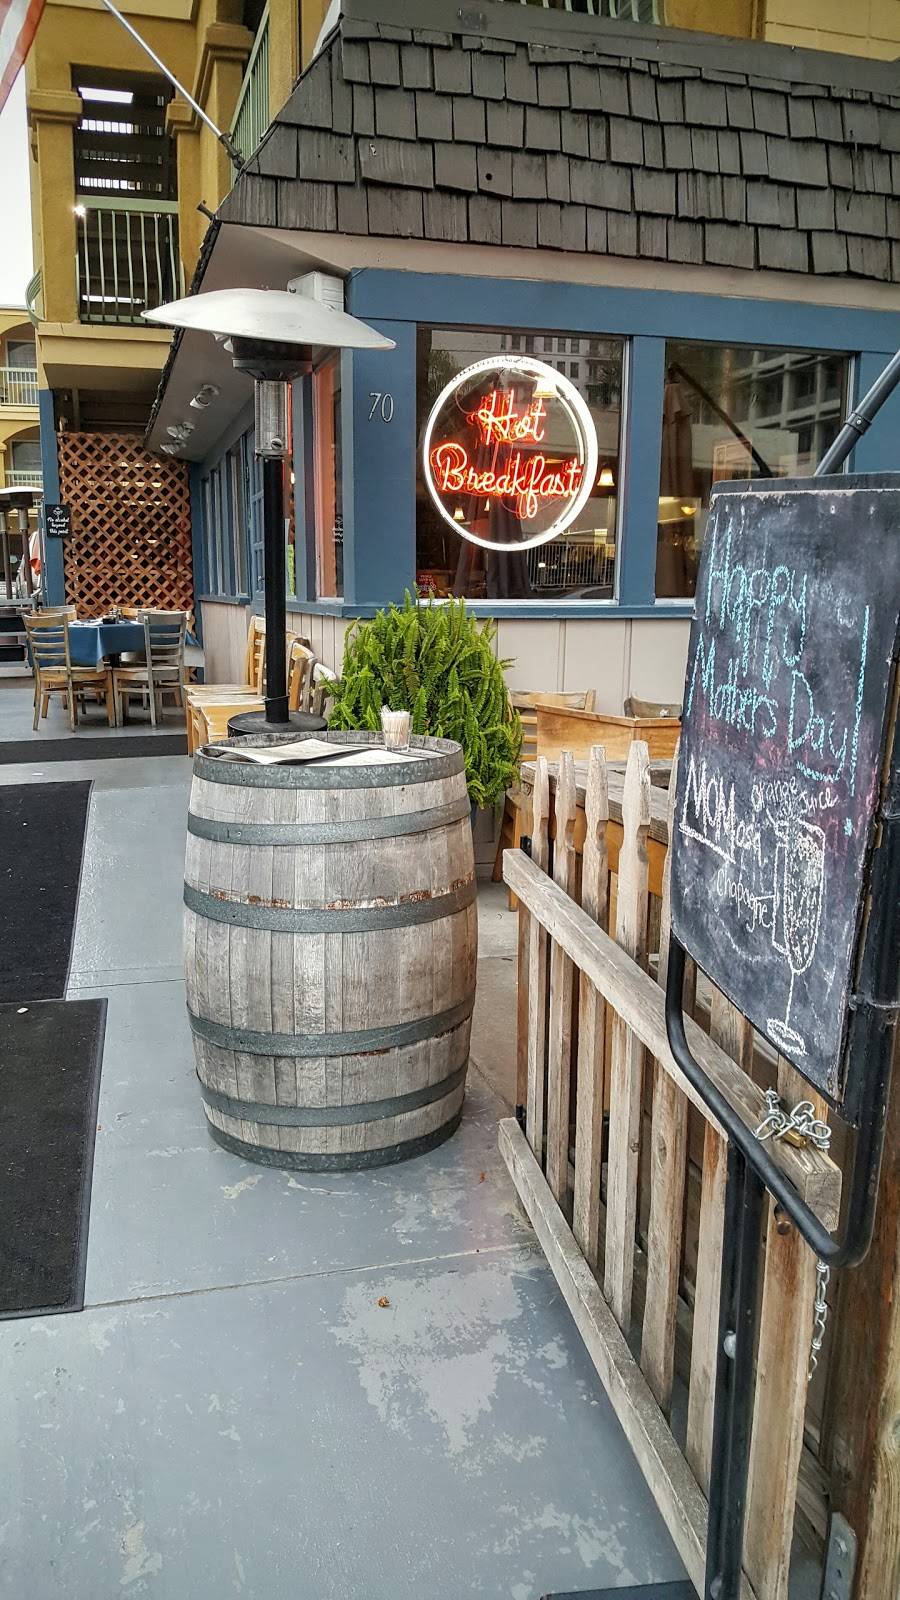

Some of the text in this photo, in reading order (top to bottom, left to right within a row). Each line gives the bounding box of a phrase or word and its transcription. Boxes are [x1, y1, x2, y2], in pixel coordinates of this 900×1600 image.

[368, 392, 394, 423] 70
[476, 389, 547, 445] Hot
[433, 443, 582, 518] Breakfast
[705, 512, 808, 697] Happy
